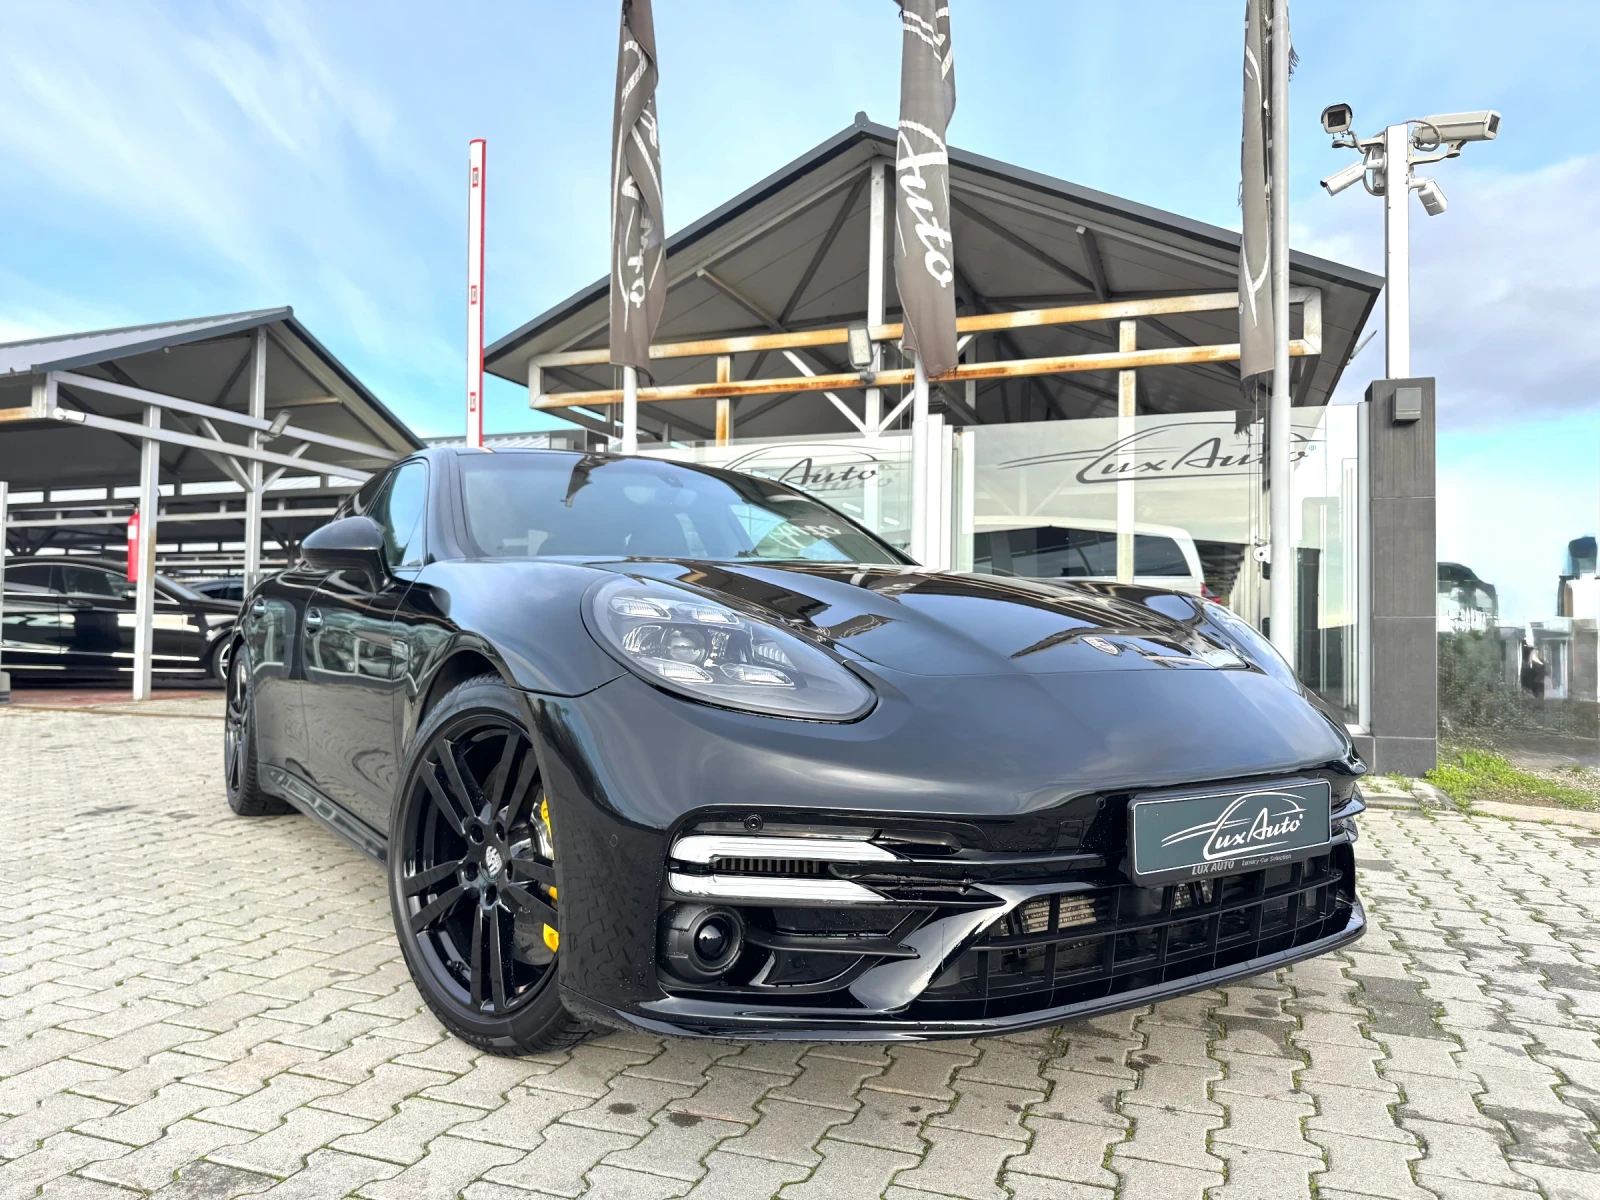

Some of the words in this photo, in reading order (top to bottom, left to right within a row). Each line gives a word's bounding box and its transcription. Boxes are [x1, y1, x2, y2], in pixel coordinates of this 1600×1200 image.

[896, 119, 953, 288] Auto
[778, 457, 878, 486] Auto
[1246, 807, 1302, 843] Auto
[1191, 863, 1209, 875] LUX
[1210, 860, 1235, 872] AUTO
[1270, 854, 1292, 862] Selection
